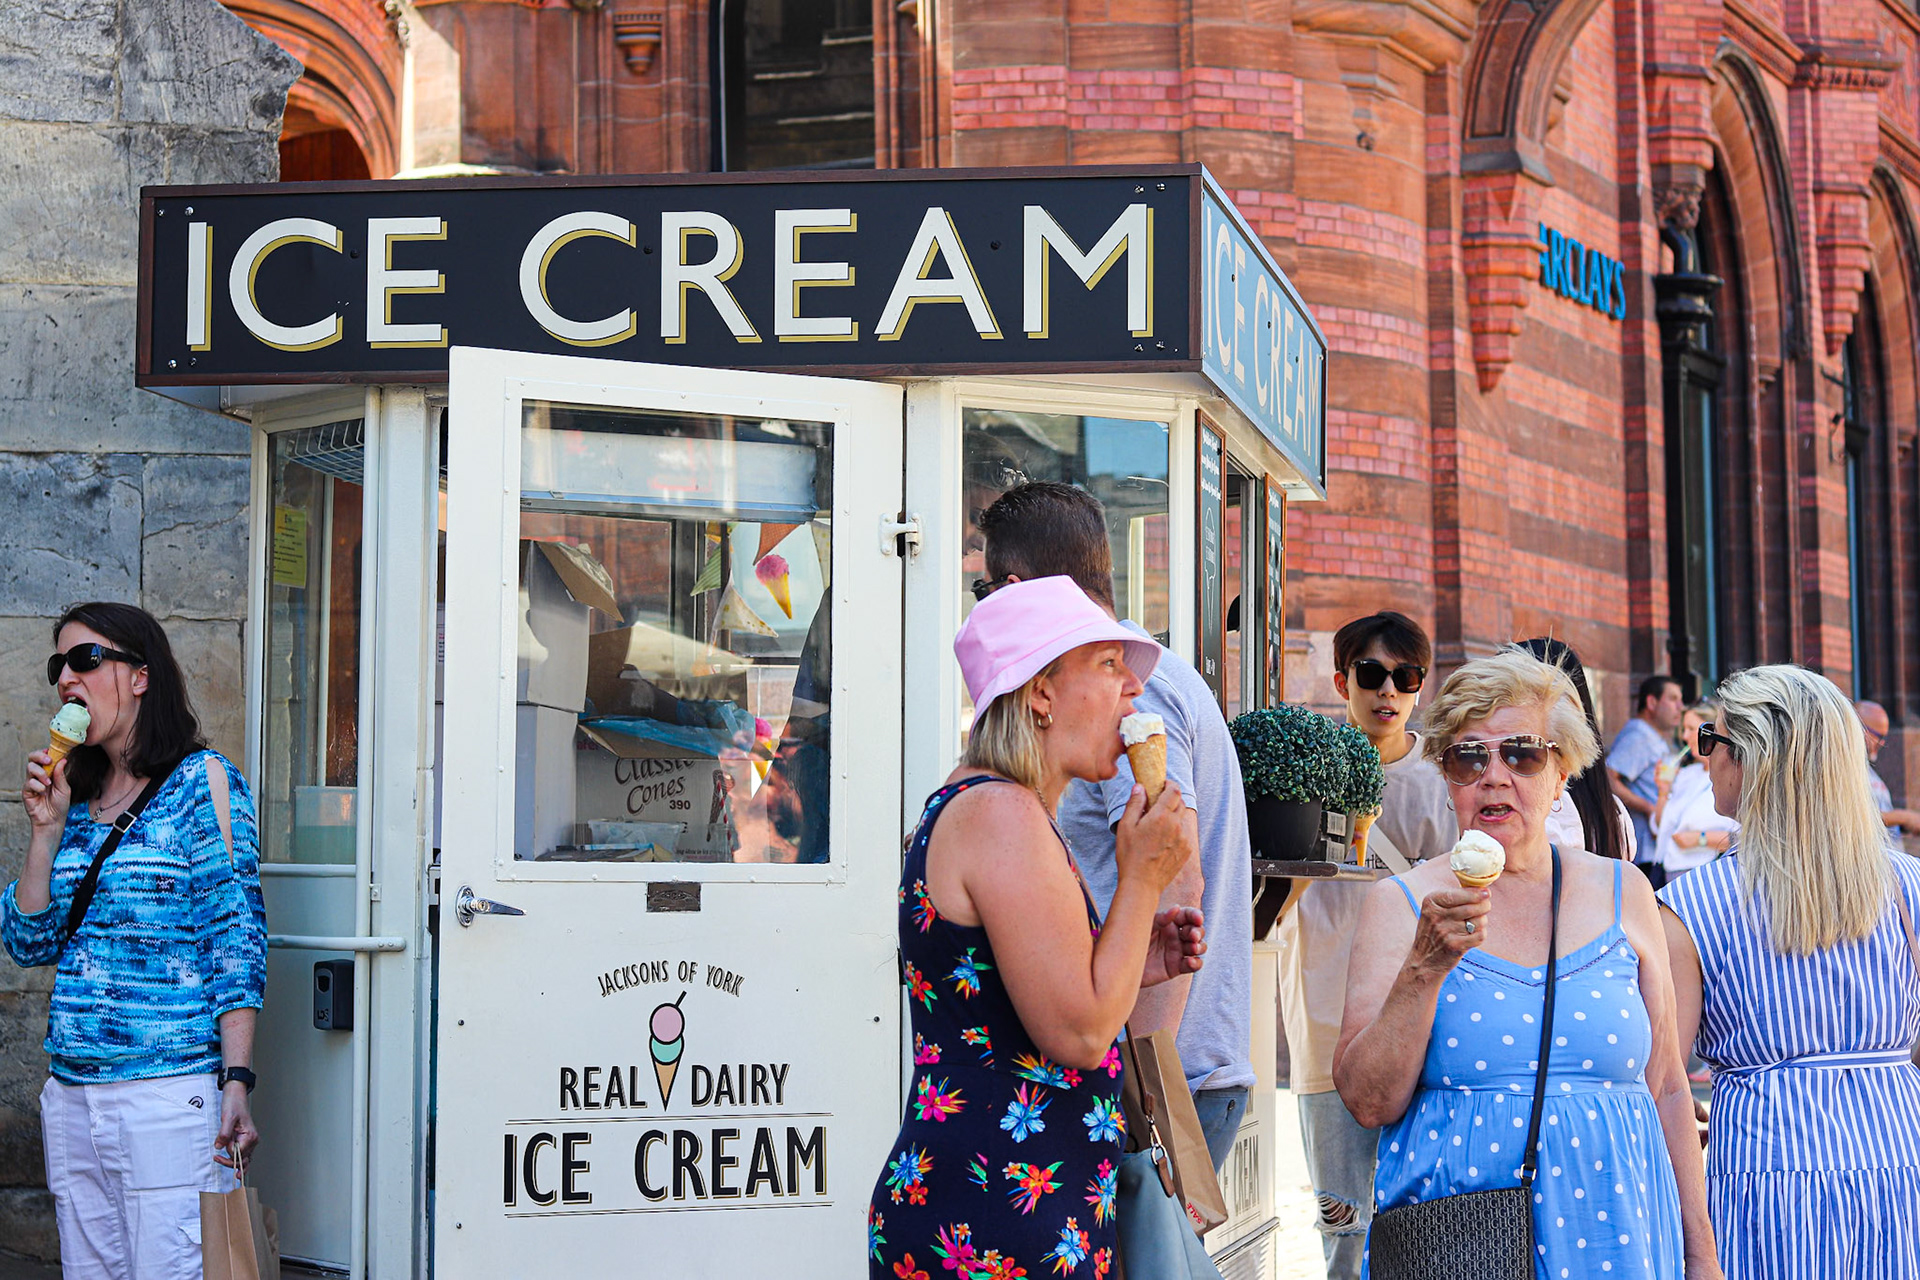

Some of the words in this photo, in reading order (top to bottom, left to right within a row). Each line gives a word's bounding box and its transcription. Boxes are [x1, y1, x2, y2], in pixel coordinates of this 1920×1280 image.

[186, 217, 448, 352] ICE
[518, 203, 1153, 347] CREAM
[1207, 206, 1246, 387] ICE
[1254, 274, 1319, 467] CREAM
[627, 776, 686, 815] Cones
[669, 800, 691, 810] 390
[597, 960, 670, 997] JACKSONS
[677, 960, 698, 984] OF
[706, 964, 745, 997] YORK
[560, 1065, 648, 1110] REAL
[691, 1063, 790, 1107] DAIRY
[503, 1132, 592, 1207] ICE
[634, 1126, 828, 1203] CREAM
[1234, 1134, 1260, 1216] CREAM
[1186, 1201, 1203, 1225] SALE
